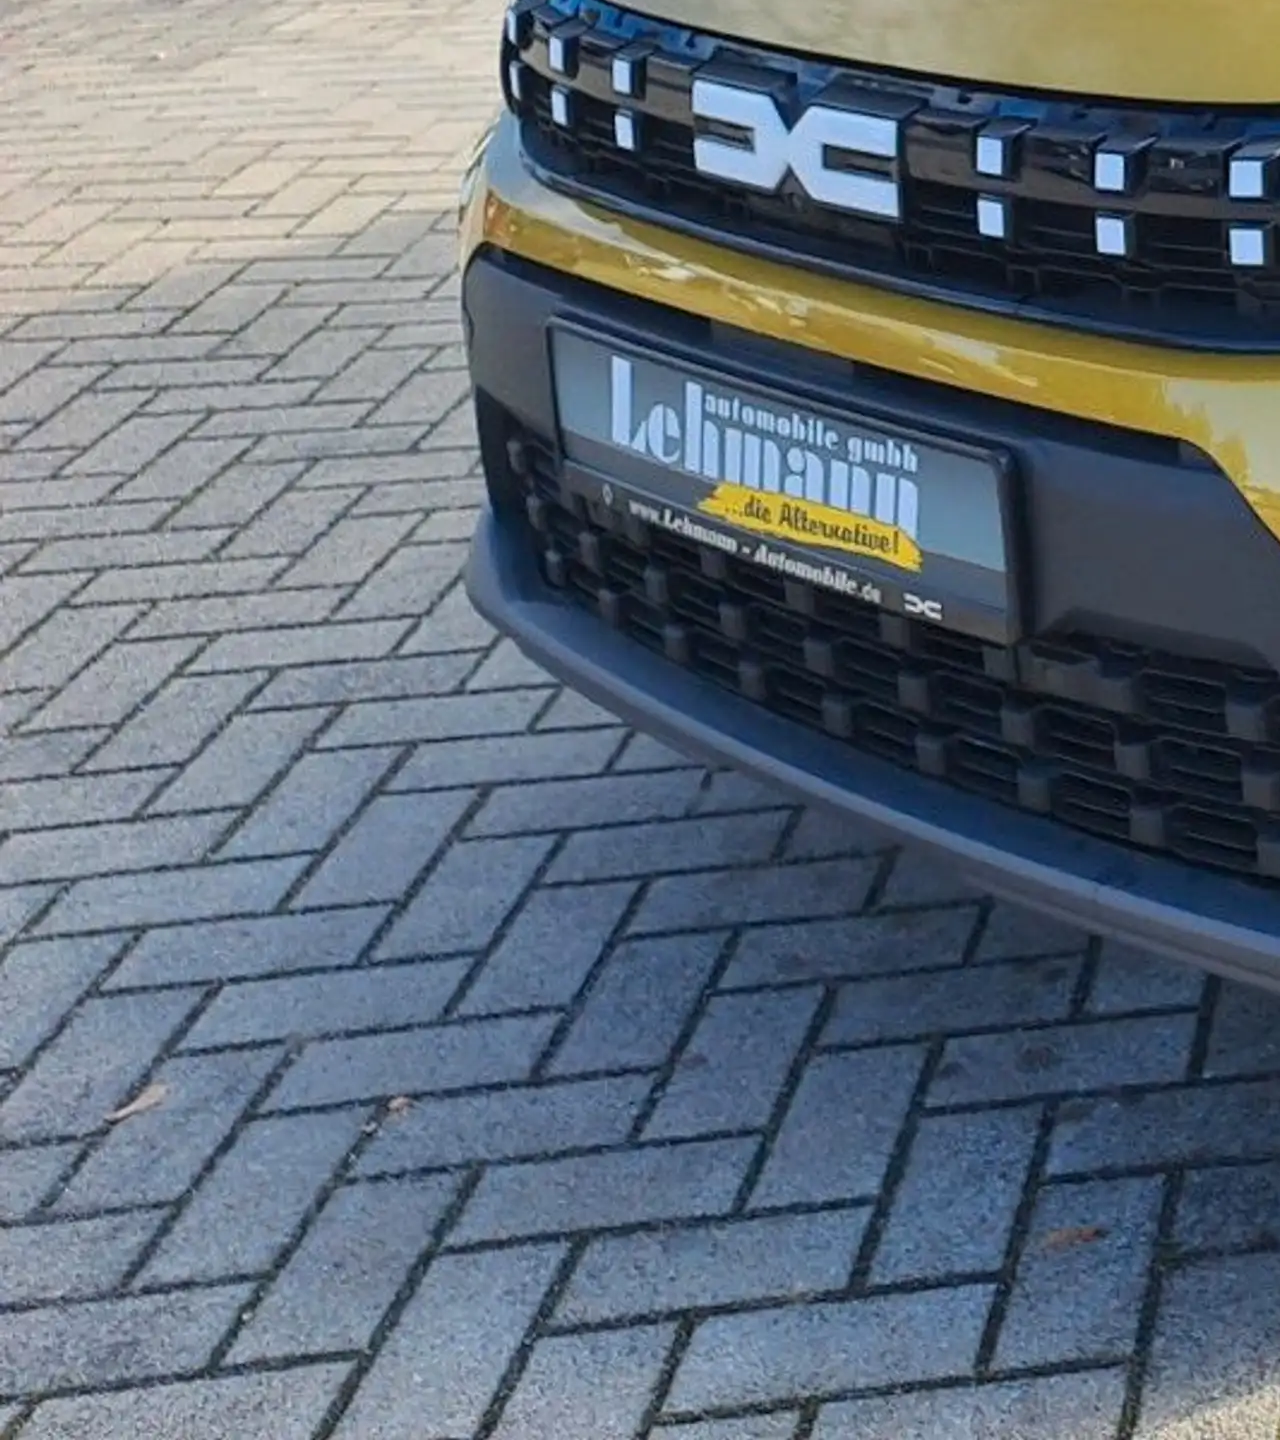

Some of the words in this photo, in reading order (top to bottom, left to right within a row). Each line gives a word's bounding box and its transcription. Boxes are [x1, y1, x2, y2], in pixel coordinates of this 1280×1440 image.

[611, 355, 918, 542] Lehmann
[704, 393, 839, 451] automobile
[847, 436, 918, 473] gmbh
[778, 502, 900, 555] Alternative!
